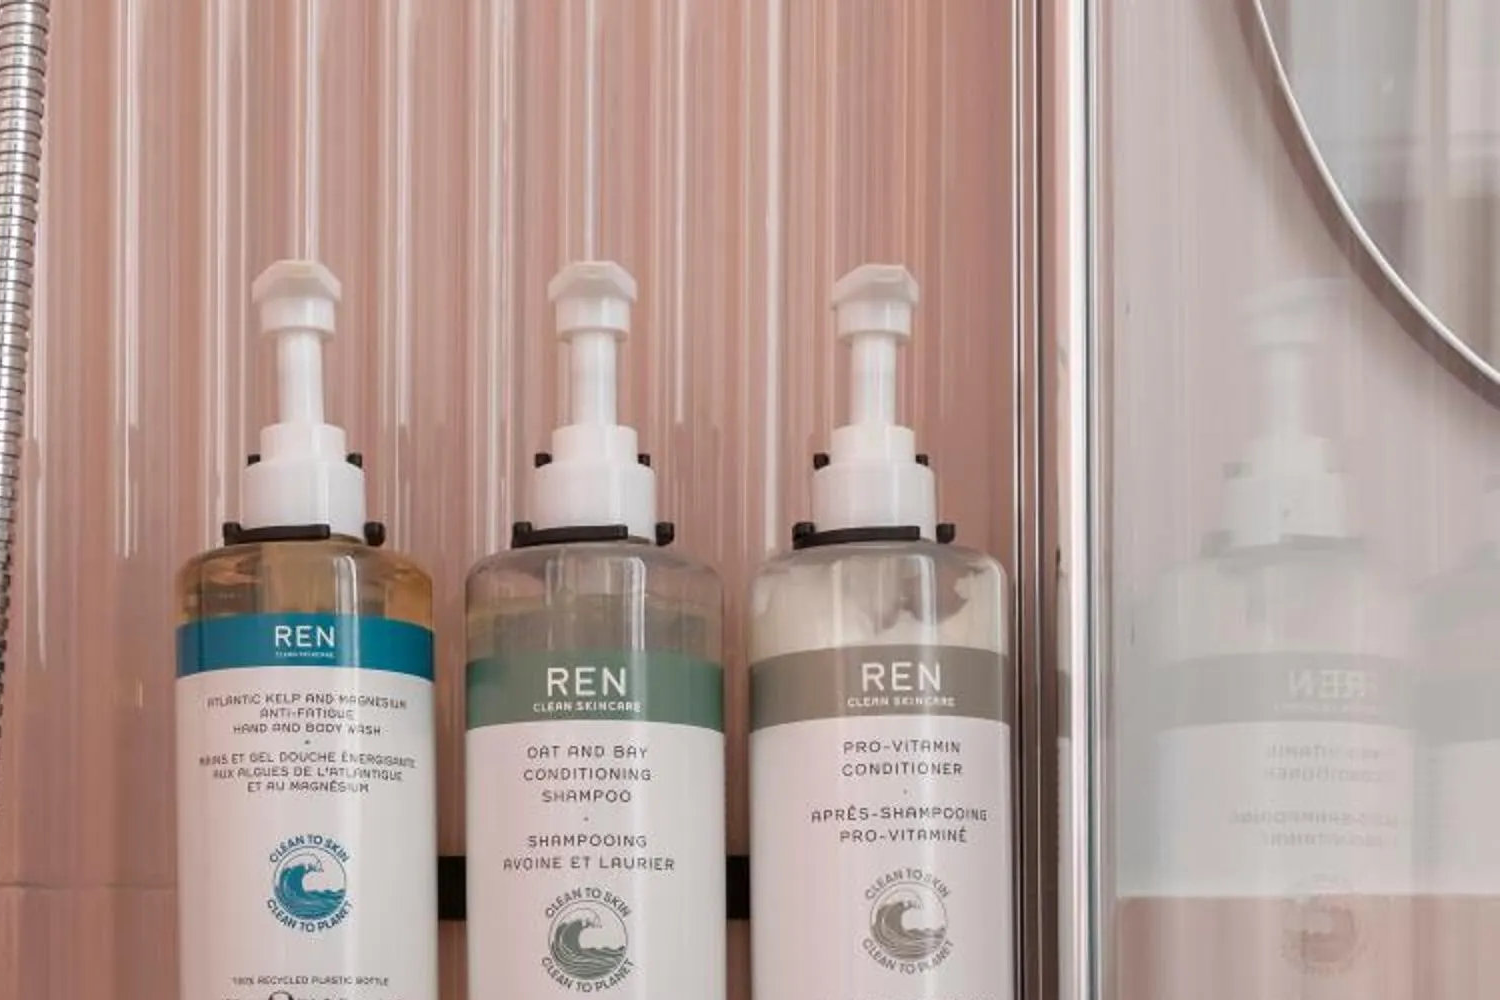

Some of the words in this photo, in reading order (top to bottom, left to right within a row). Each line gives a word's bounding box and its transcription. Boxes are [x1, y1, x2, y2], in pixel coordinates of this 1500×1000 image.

[275, 624, 335, 647] REN
[547, 666, 627, 697] REN
[861, 661, 941, 692] REN
[207, 693, 260, 708] ATLANTIC
[265, 693, 301, 704] KELP
[305, 693, 335, 705] AND
[533, 701, 573, 713] CLEAN
[575, 701, 642, 713] SKINCARE
[260, 706, 355, 719] ANTI-FATIGUE
[233, 722, 268, 734] HAND
[272, 722, 301, 734] AND
[305, 722, 342, 733] BODY
[526, 745, 560, 760] OAT
[567, 745, 605, 759] AND
[613, 745, 648, 760] BAY
[843, 739, 961, 755] PRO-VITAMIN
[231, 752, 245, 765] ET
[249, 751, 274, 763] GEL
[279, 751, 337, 763] DOUCHE
[213, 768, 235, 779] AUX
[237, 766, 289, 778] ALGUES
[293, 766, 312, 777] DE
[523, 767, 651, 782] CONDITIONING
[841, 762, 963, 777] CONDITIONER
[247, 781, 261, 792] ET
[266, 781, 285, 791] AU
[541, 789, 632, 803] SHAMPOO
[307, 834, 324, 845] TO
[528, 834, 647, 848] SHAMPOOING
[839, 826, 967, 843] PRO-VITAMINÉ
[503, 856, 562, 872] AVOINE
[570, 856, 591, 870] ET
[599, 856, 675, 871] LAURIER
[906, 867, 923, 881] TO
[545, 887, 582, 918] CLEAN
[585, 887, 602, 899] TO
[299, 921, 316, 933] TO
[899, 962, 916, 975] TO
[917, 939, 954, 973] PANET
[257, 975, 309, 985] RECYCLED
[575, 981, 593, 993] TO
